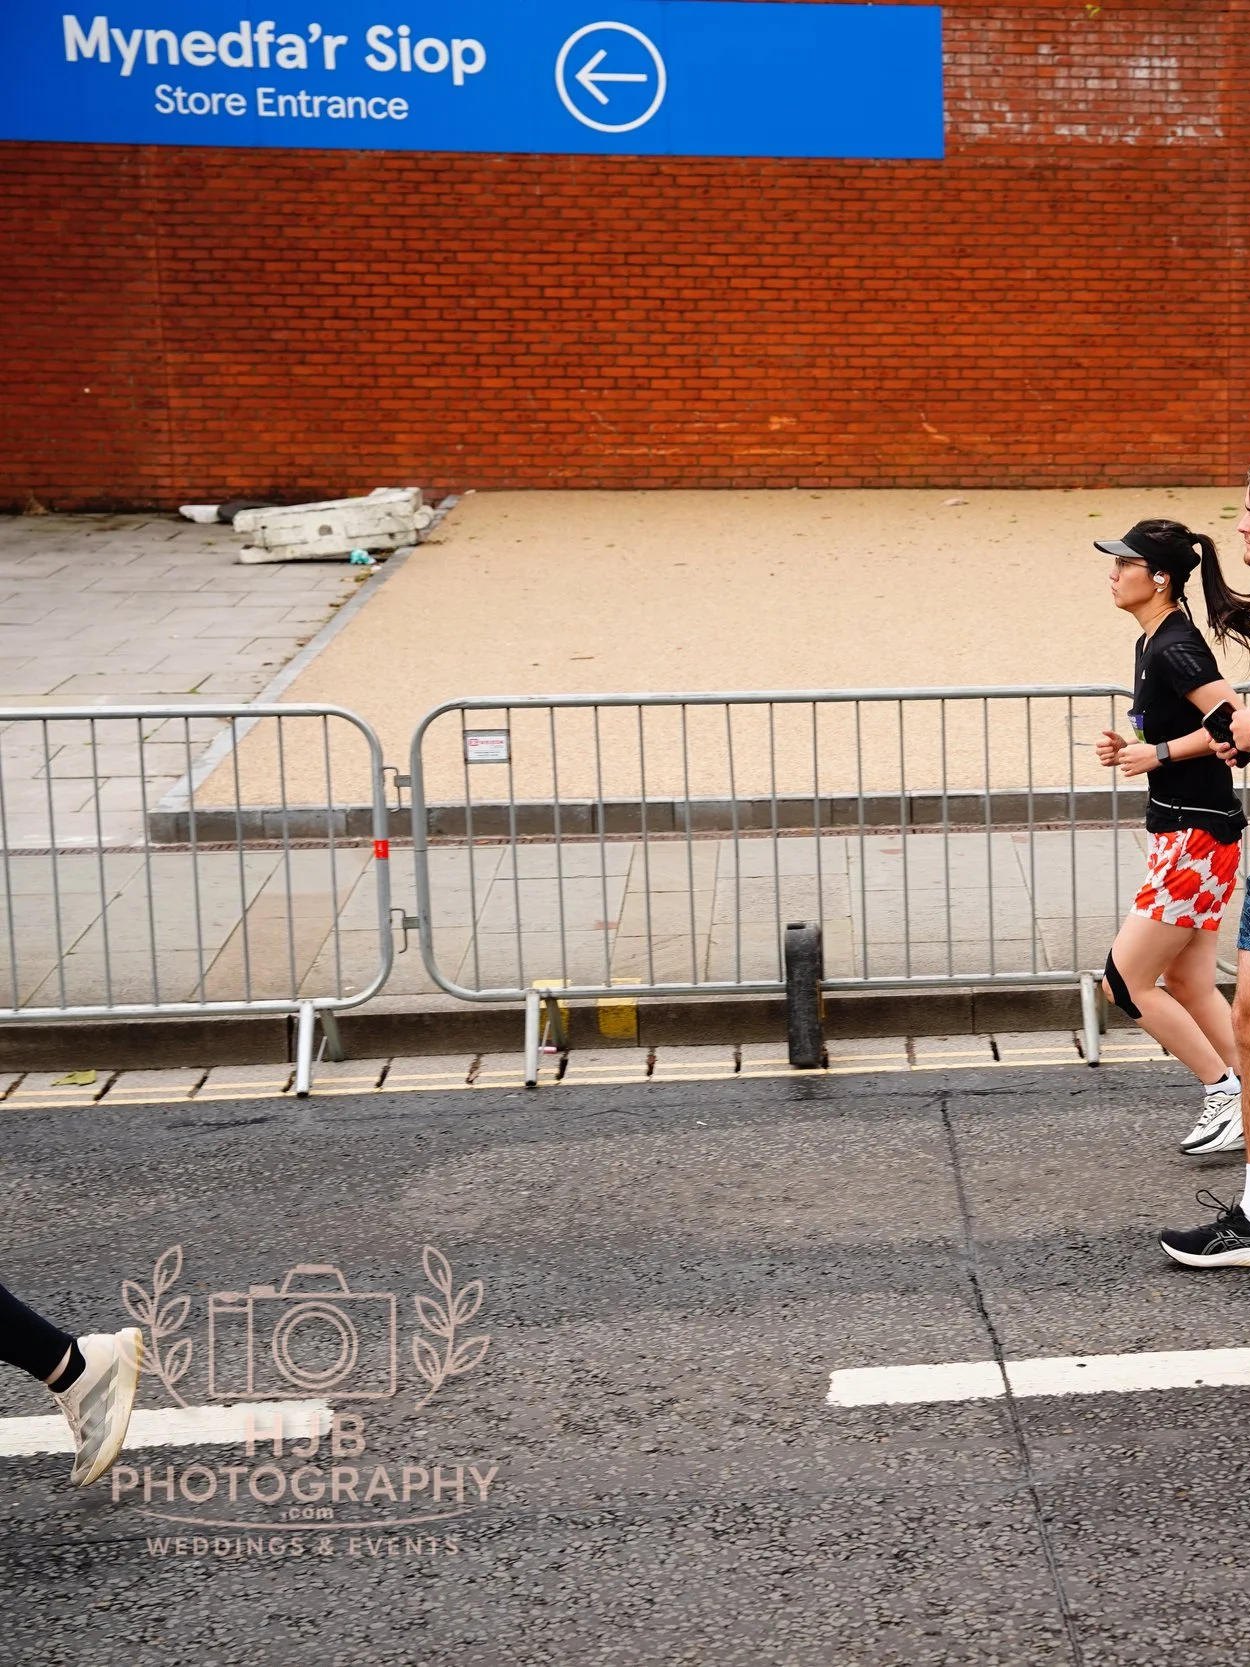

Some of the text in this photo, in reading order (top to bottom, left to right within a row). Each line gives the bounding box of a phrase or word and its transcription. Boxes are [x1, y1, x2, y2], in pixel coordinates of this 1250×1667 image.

[365, 24, 487, 86] Siop
[154, 84, 409, 120] Store Entrance
